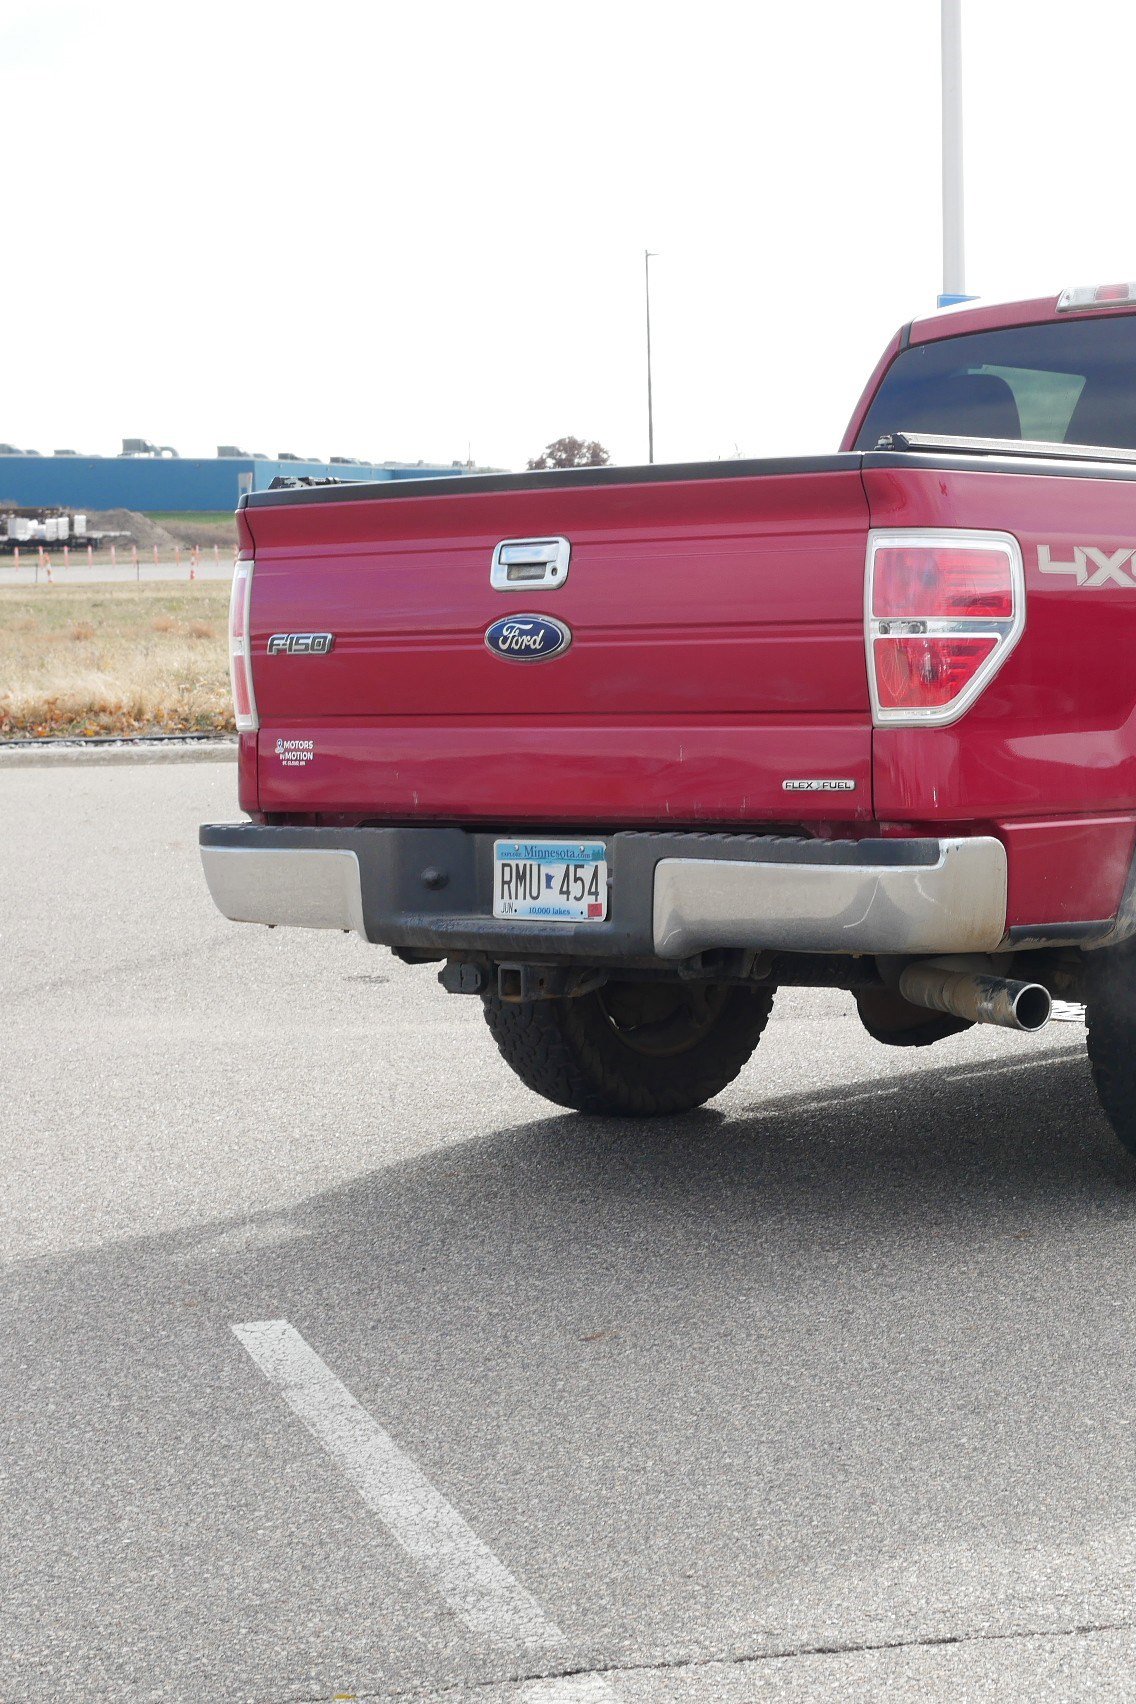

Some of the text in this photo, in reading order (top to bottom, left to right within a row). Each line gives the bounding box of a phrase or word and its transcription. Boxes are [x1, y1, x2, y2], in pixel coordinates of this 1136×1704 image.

[499, 623, 544, 650] Ford
[267, 633, 333, 655] F-150
[283, 741, 313, 749] MOTORS
[285, 752, 314, 760] MOTION
[785, 781, 851, 789] FLEX FUEL
[500, 862, 600, 902] RMU 454
[500, 901, 514, 914] JUN
[528, 906, 571, 916] 10,000 lakes
